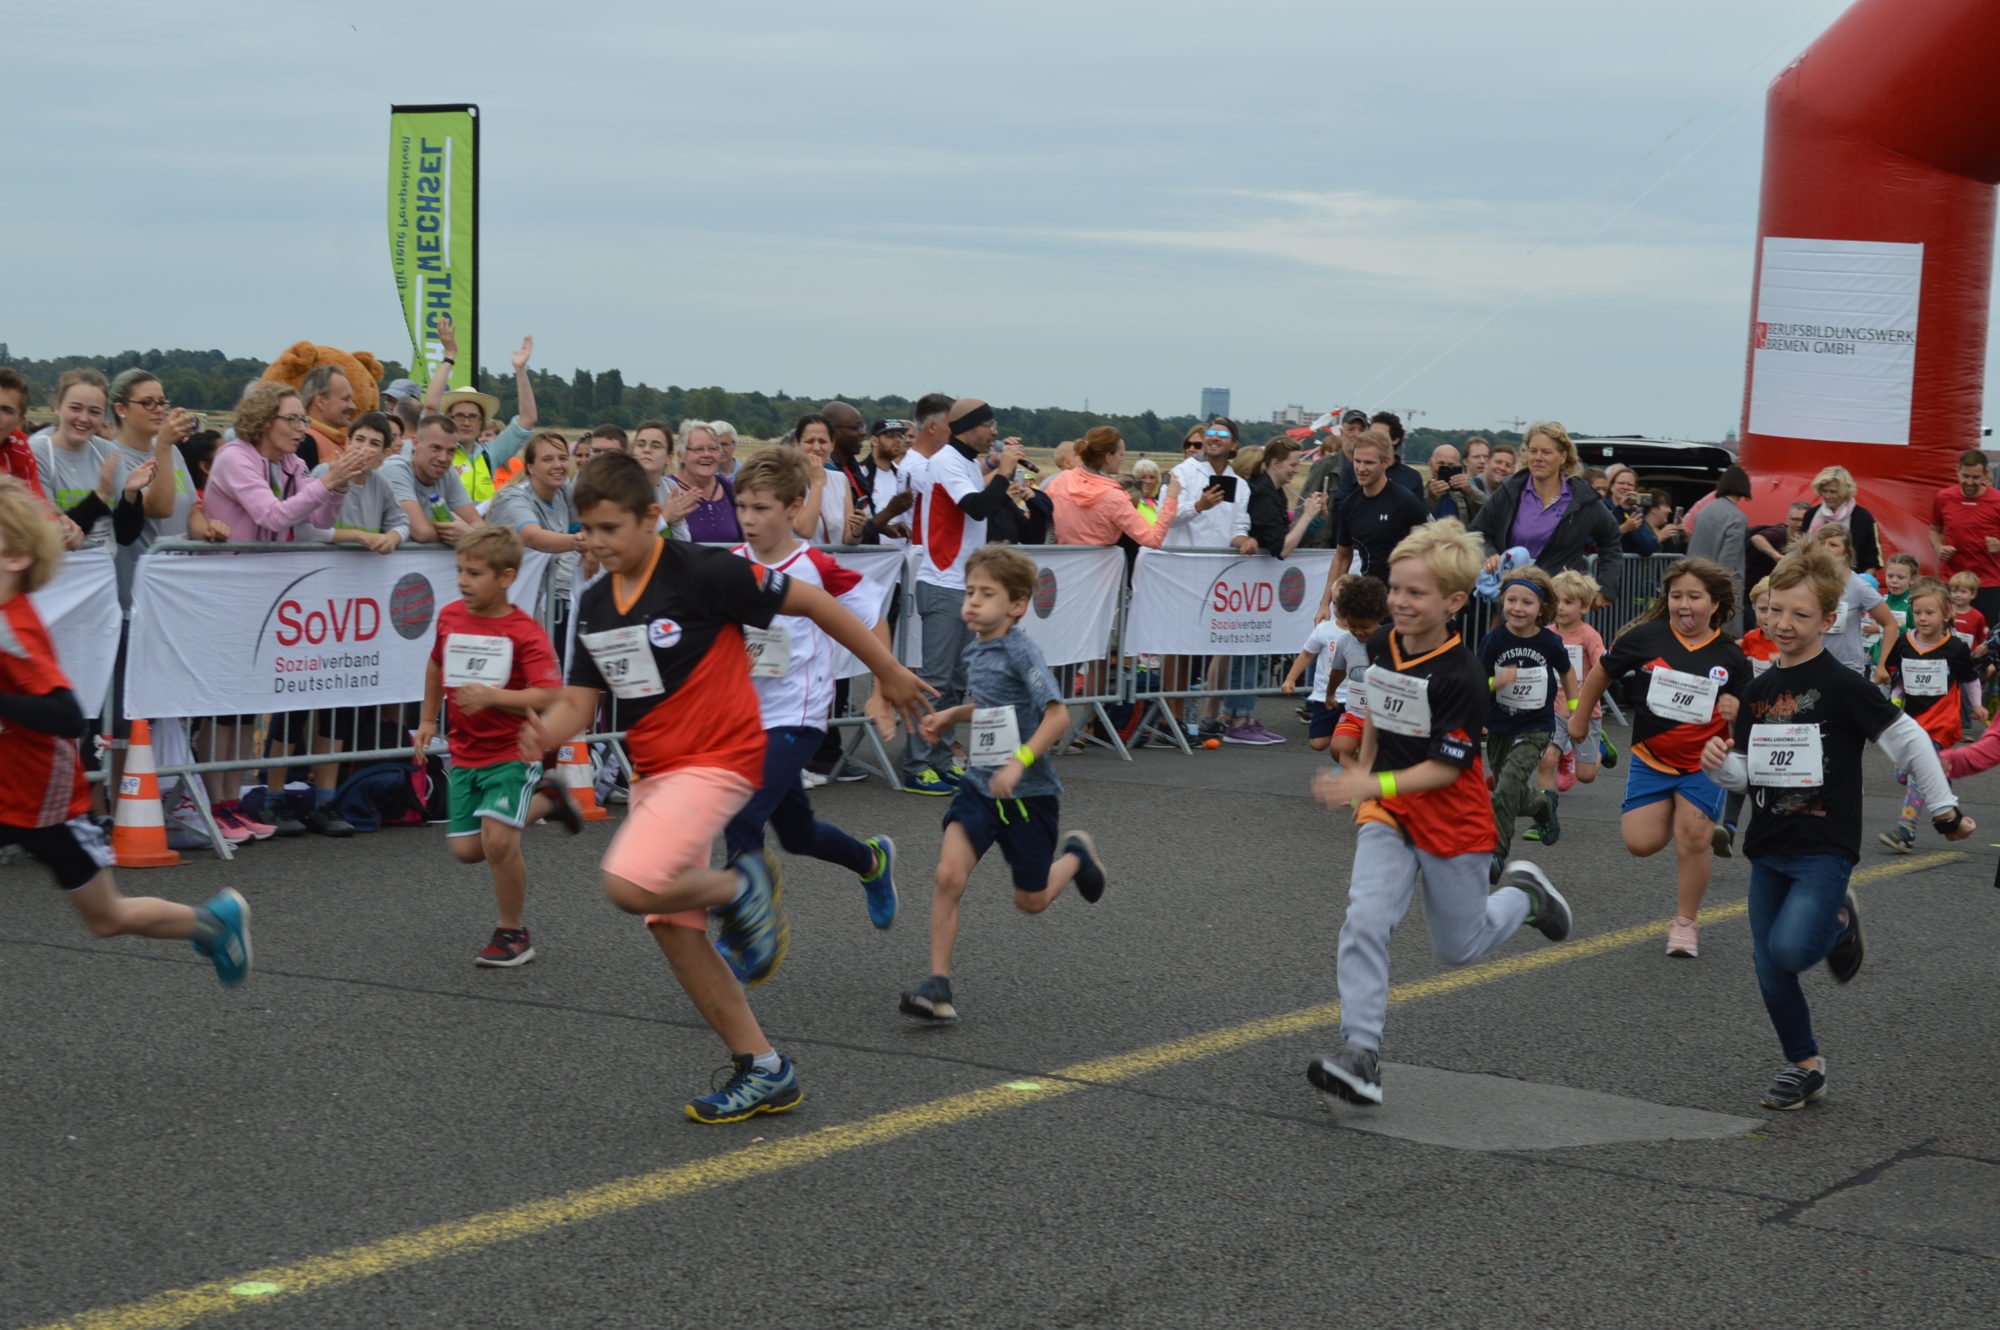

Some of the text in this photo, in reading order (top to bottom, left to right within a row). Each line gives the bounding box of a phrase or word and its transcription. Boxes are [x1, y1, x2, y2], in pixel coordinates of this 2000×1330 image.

[1768, 322, 1915, 342] BERUFSBILDUNGSWERK
[1767, 338, 1856, 355] BREMEN GMBH
[1213, 581, 1274, 612] SoVD
[276, 597, 380, 646] SoVD
[1211, 619, 1272, 630] Sozialverband
[1210, 632, 1271, 643] Deutschland
[275, 651, 380, 673] Sozialverband
[274, 671, 379, 694] Deutschland
[1914, 674, 1931, 683] 520
[1512, 685, 1532, 695] 522
[1671, 691, 1694, 706] 518
[1384, 696, 1404, 713] 517
[1769, 750, 1795, 766] 202
